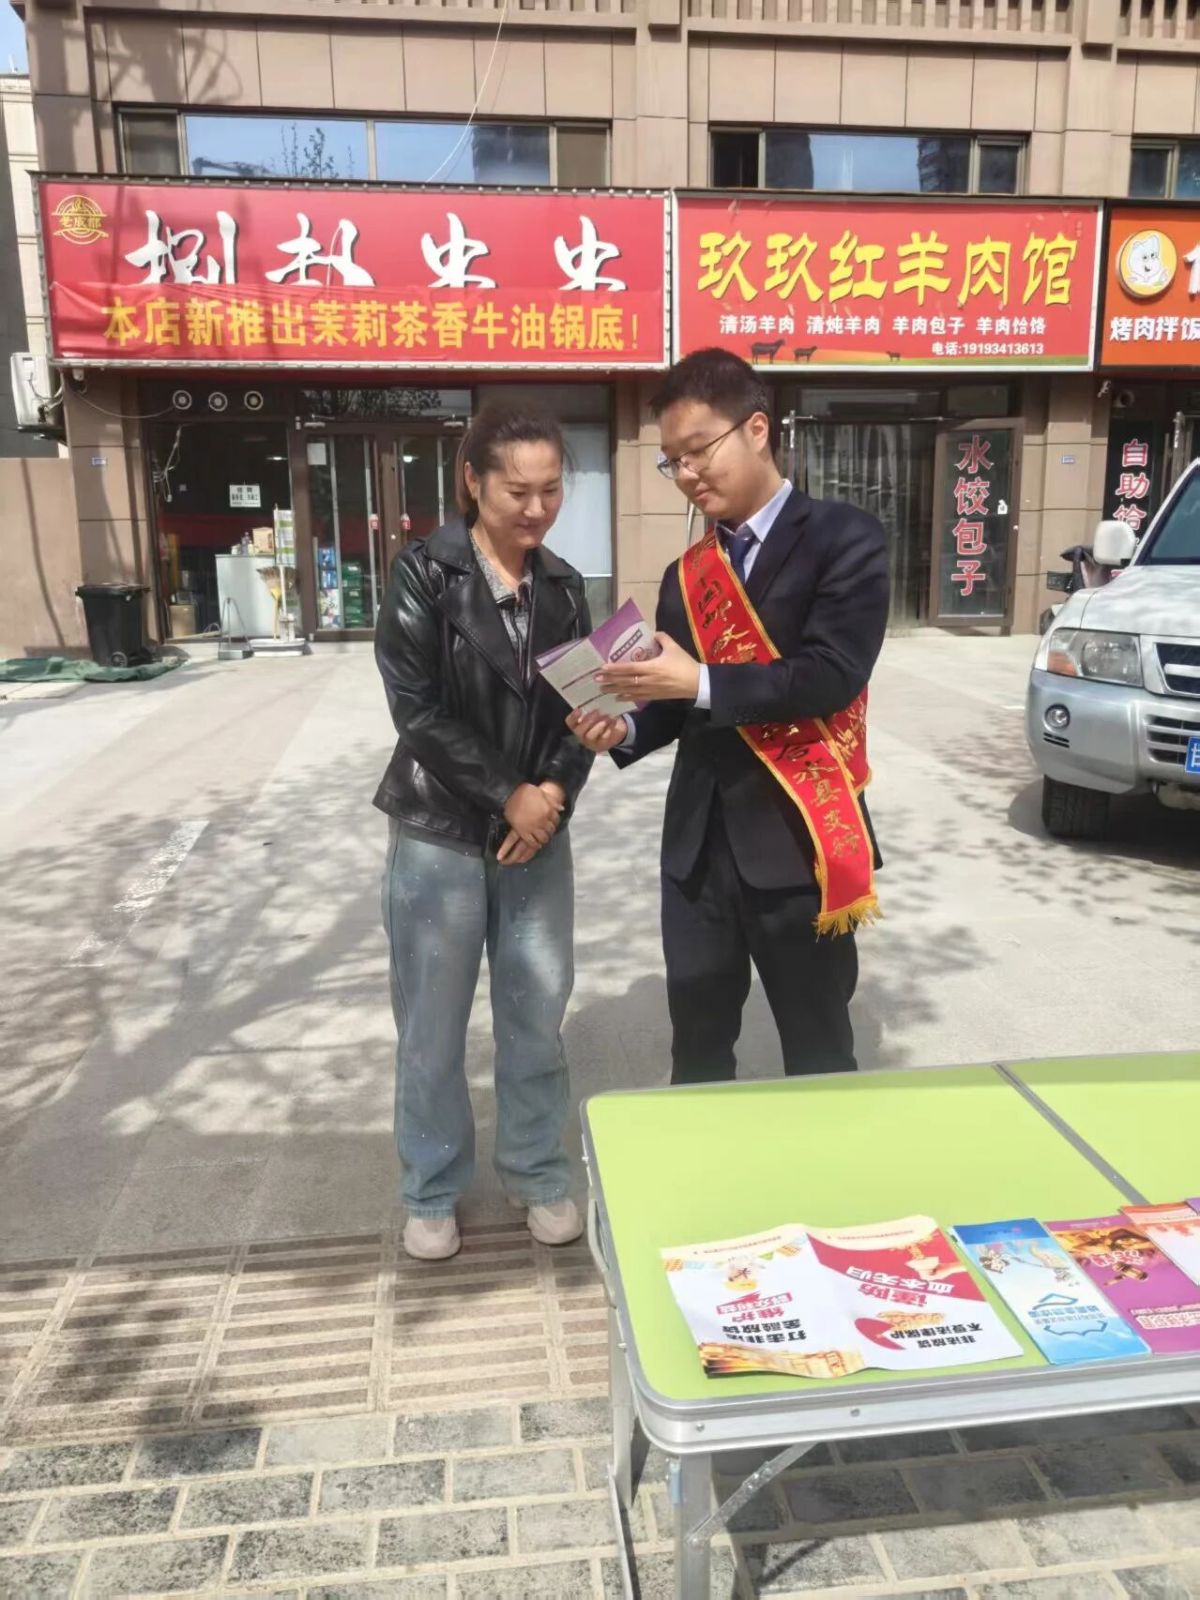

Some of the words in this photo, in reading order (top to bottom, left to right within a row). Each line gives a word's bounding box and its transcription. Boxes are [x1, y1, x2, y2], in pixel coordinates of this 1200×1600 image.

[697, 229, 1079, 307] 玖玖红羊肉馆
[719, 314, 795, 336] 清汤羊肉
[806, 315, 881, 336] 清炖羊肉
[892, 316, 966, 336] 羊肉包子
[975, 316, 1047, 336] 羊肉饸饹
[1110, 316, 1200, 341] 烤肉拌饭
[1111, 438, 1151, 546] 自助饸
[951, 434, 994, 597] 水饺包子
[846, 1266, 954, 1295] 血本无归
[858, 1284, 927, 1307] 谨防
[722, 1319, 801, 1334] 金融放贷
[890, 1323, 983, 1340] 不受法律保护
